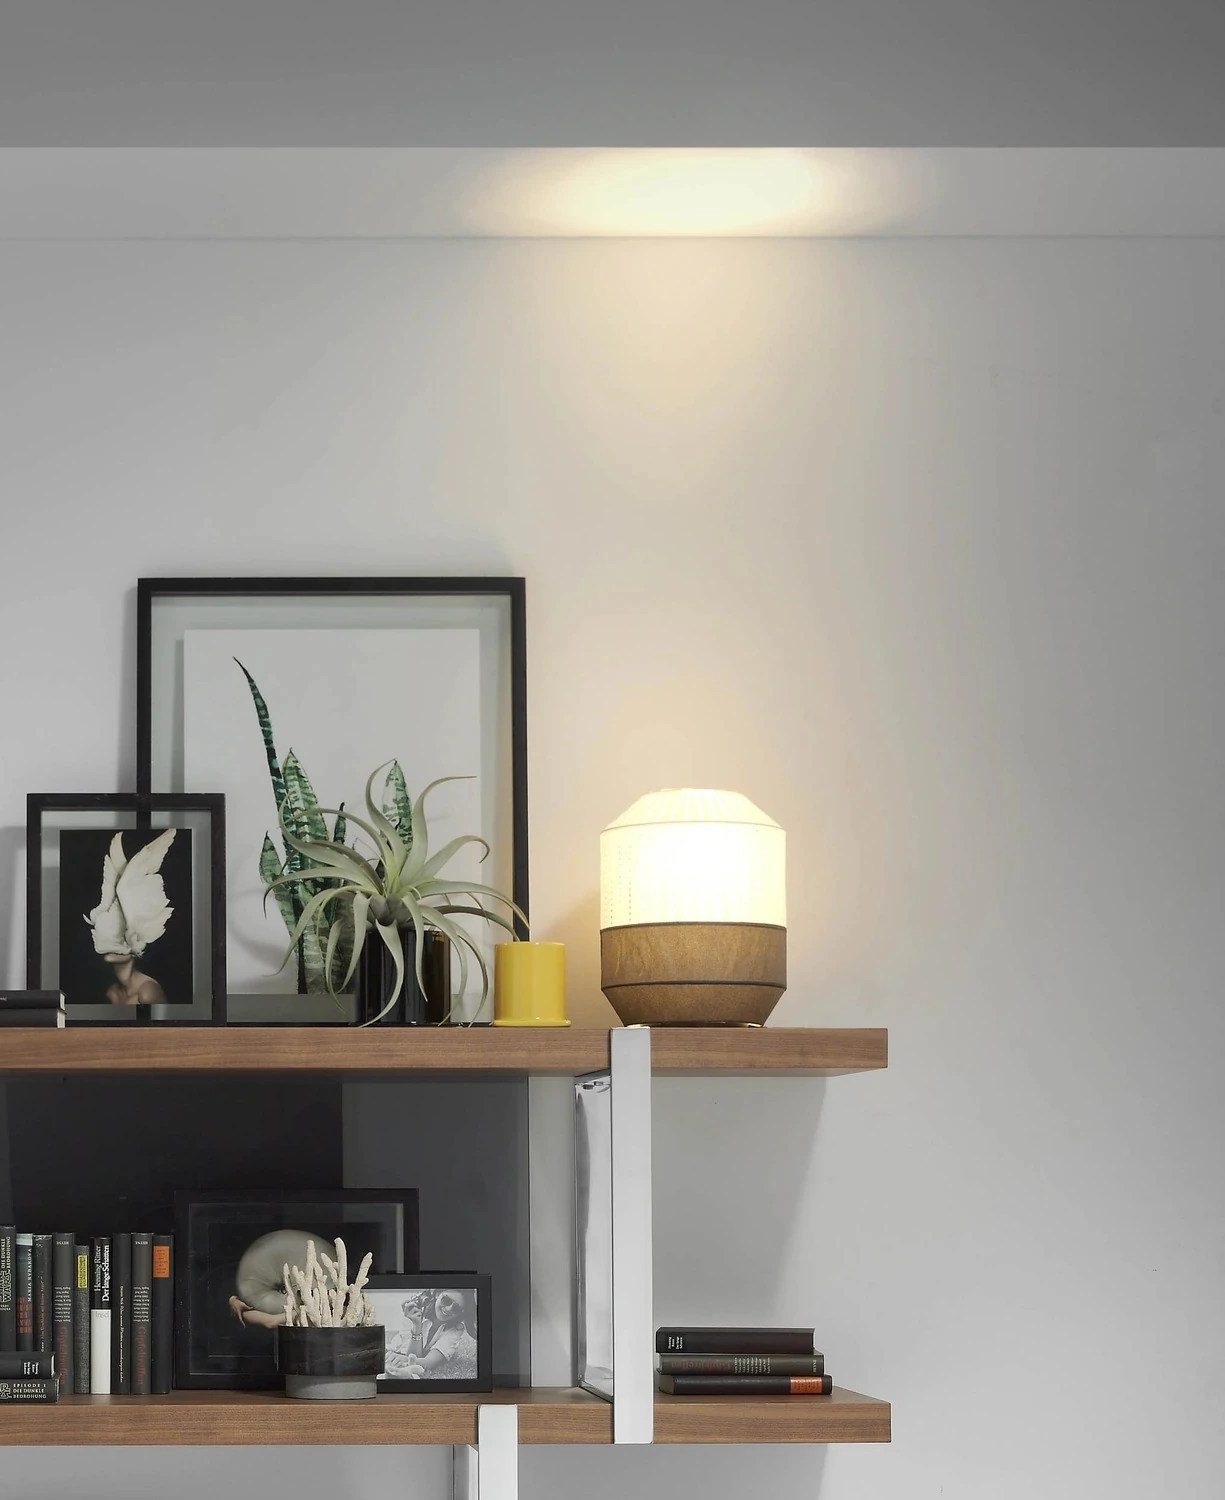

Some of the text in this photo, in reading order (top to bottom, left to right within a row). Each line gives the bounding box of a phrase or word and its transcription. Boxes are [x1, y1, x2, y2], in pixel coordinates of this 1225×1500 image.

[102, 1245, 110, 1272] Schatten
[3, 1269, 11, 1302] WARS
[94, 1264, 102, 1291] Henning
[102, 1288, 110, 1302] Der
